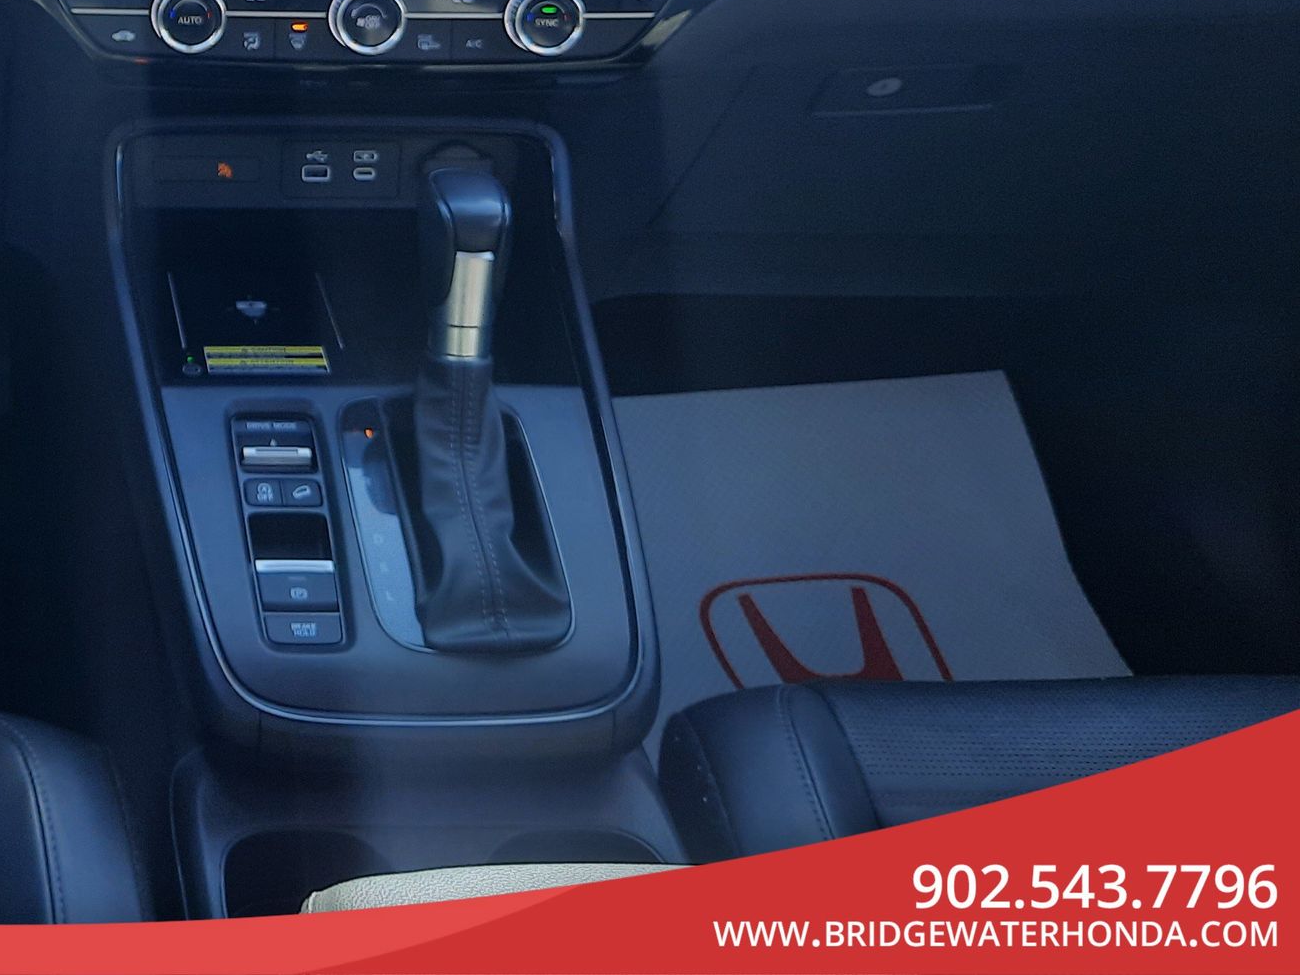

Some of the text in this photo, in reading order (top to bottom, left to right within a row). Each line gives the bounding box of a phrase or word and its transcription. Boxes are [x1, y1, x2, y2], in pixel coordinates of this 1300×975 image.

[177, 16, 203, 25] AUTO
[535, 18, 560, 28] SYNC
[465, 39, 484, 49] A/C
